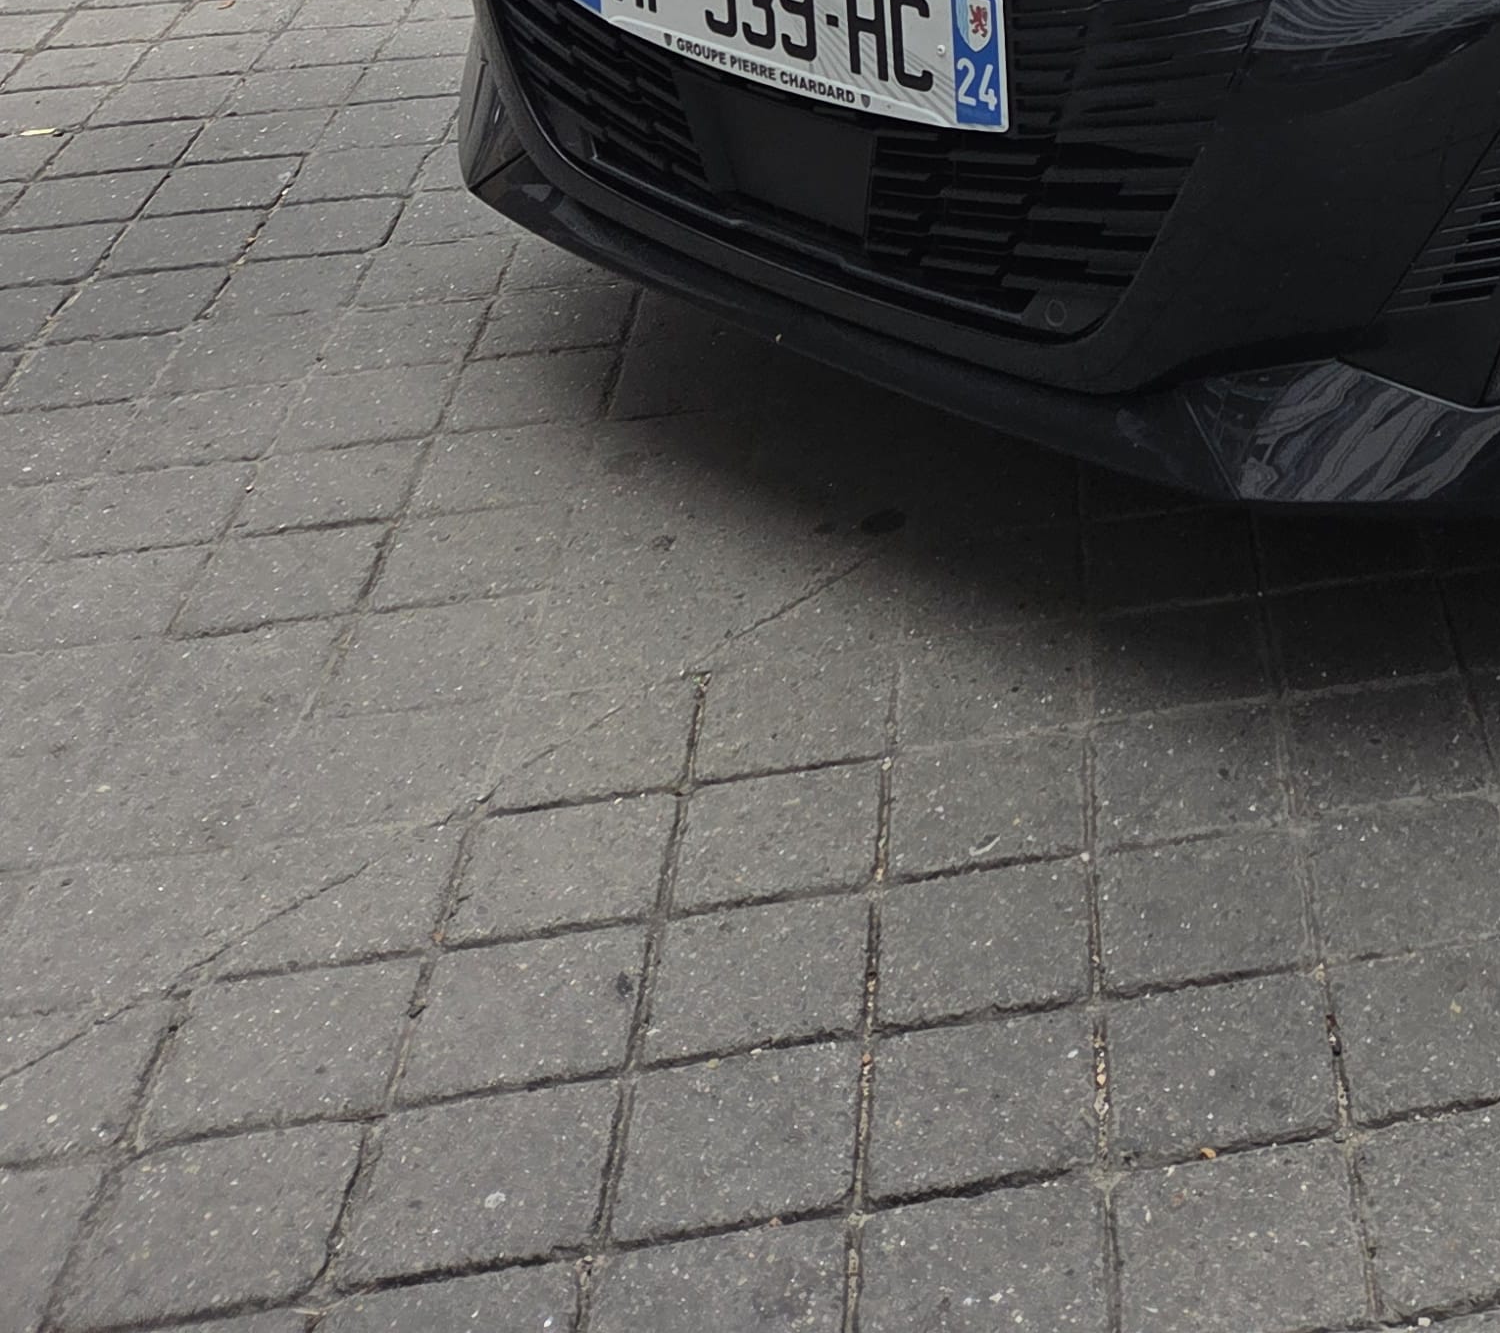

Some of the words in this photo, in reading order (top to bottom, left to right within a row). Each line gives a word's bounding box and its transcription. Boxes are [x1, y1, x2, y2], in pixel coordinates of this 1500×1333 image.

[676, 37, 727, 66] GROUPE
[730, 54, 777, 82] PIERRE
[780, 70, 856, 105] CHARDARD
[957, 58, 998, 112] 24
